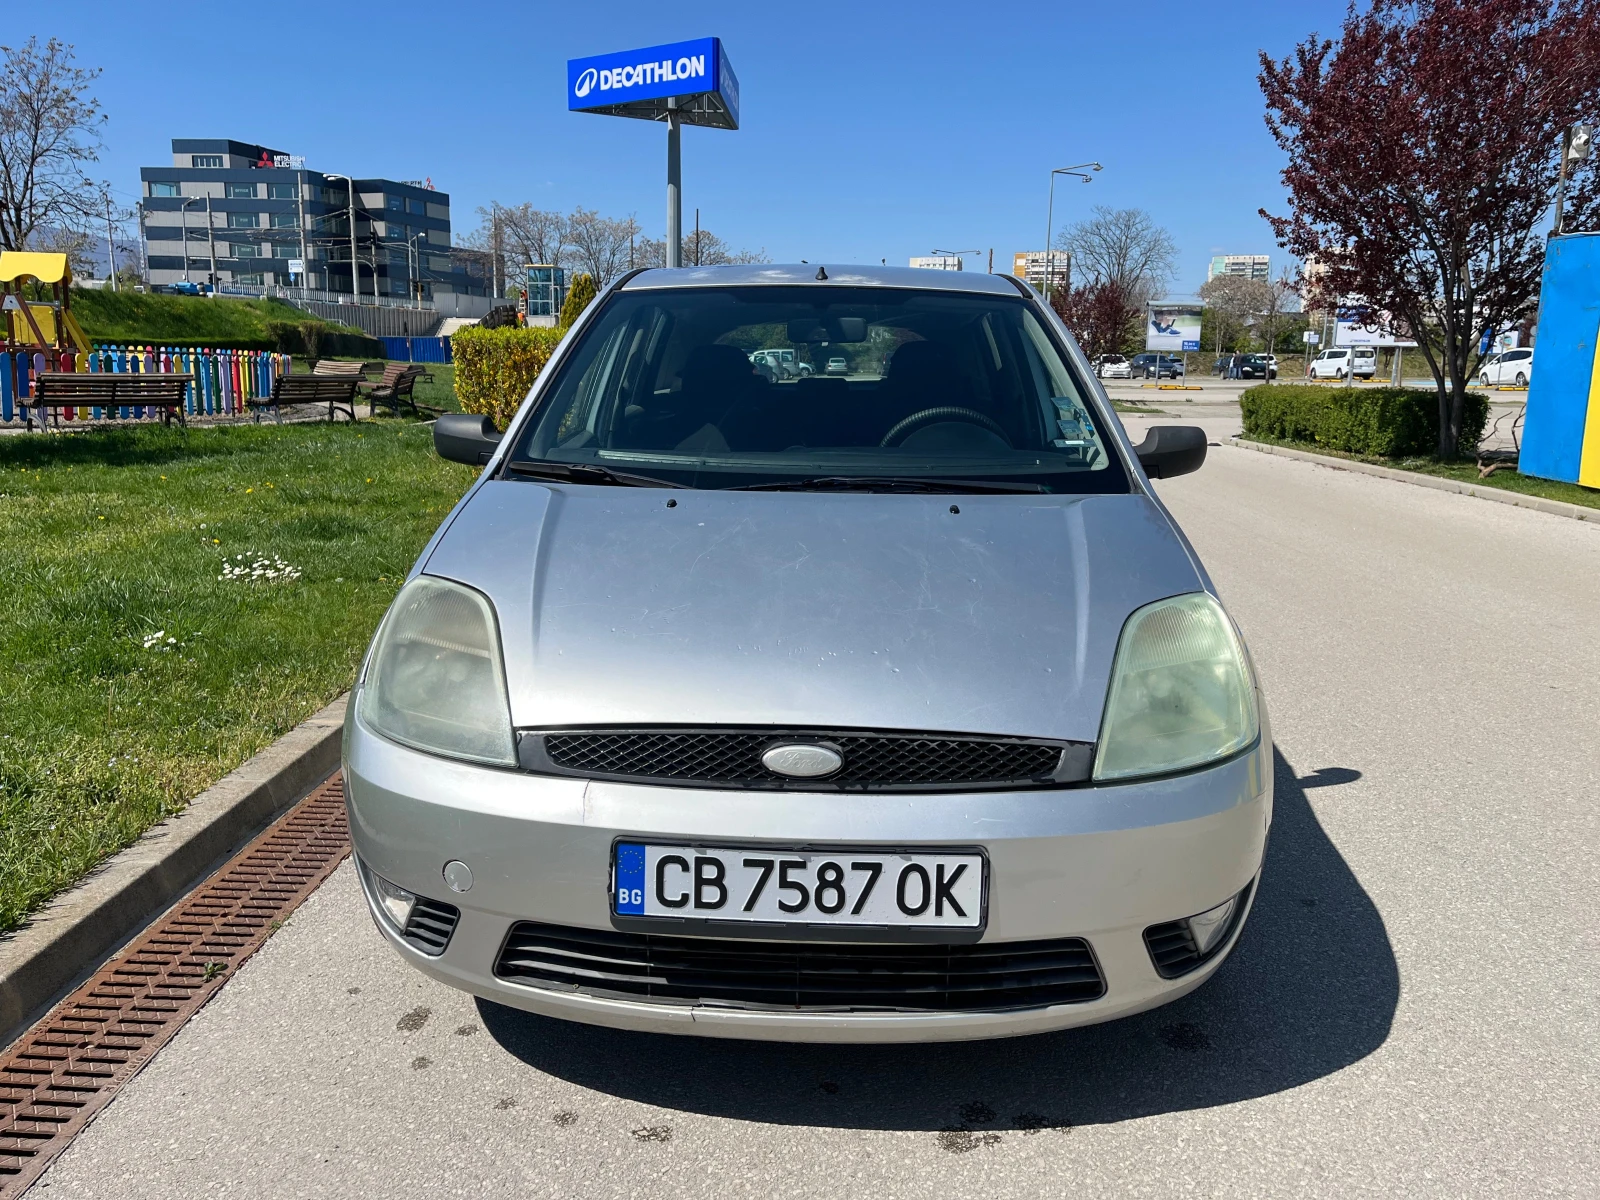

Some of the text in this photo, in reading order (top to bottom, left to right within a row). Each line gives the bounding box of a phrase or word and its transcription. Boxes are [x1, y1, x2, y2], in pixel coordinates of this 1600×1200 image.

[600, 55, 705, 90] DECATHLON
[779, 750, 824, 769] Ford
[619, 888, 642, 905] BG
[655, 854, 970, 918] CB 7587 OK
